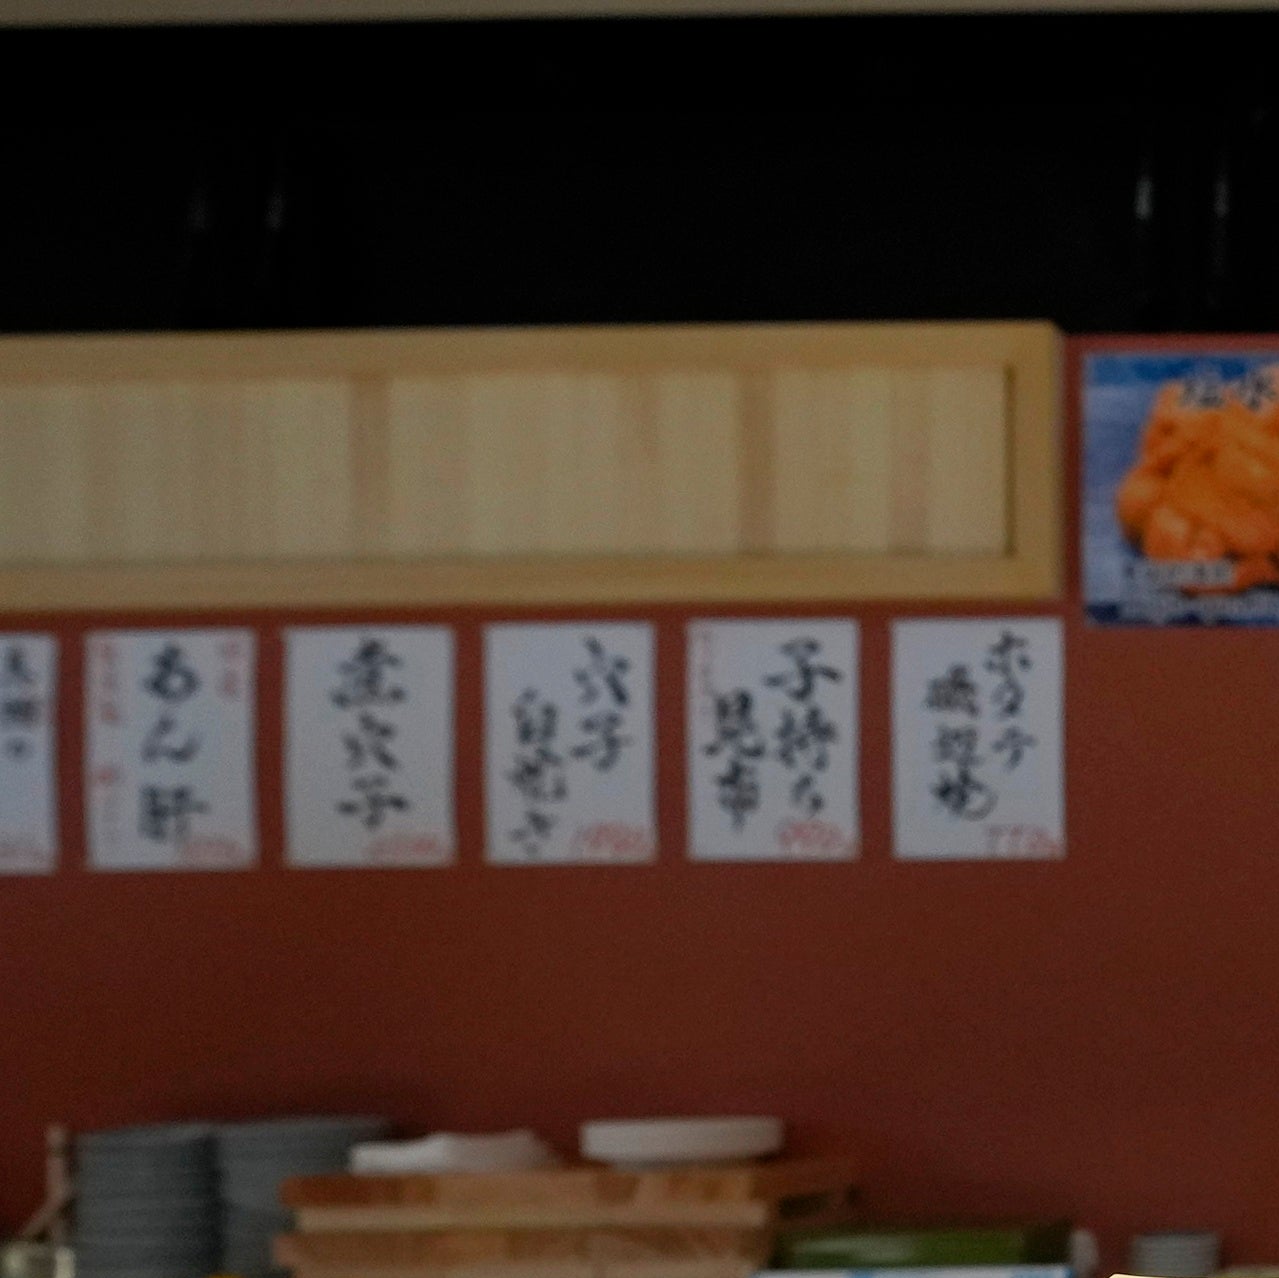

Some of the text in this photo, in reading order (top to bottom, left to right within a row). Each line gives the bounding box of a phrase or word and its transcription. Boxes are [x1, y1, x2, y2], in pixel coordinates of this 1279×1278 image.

[139, 642, 212, 844] あん肝
[763, 636, 844, 815] 子持ち
